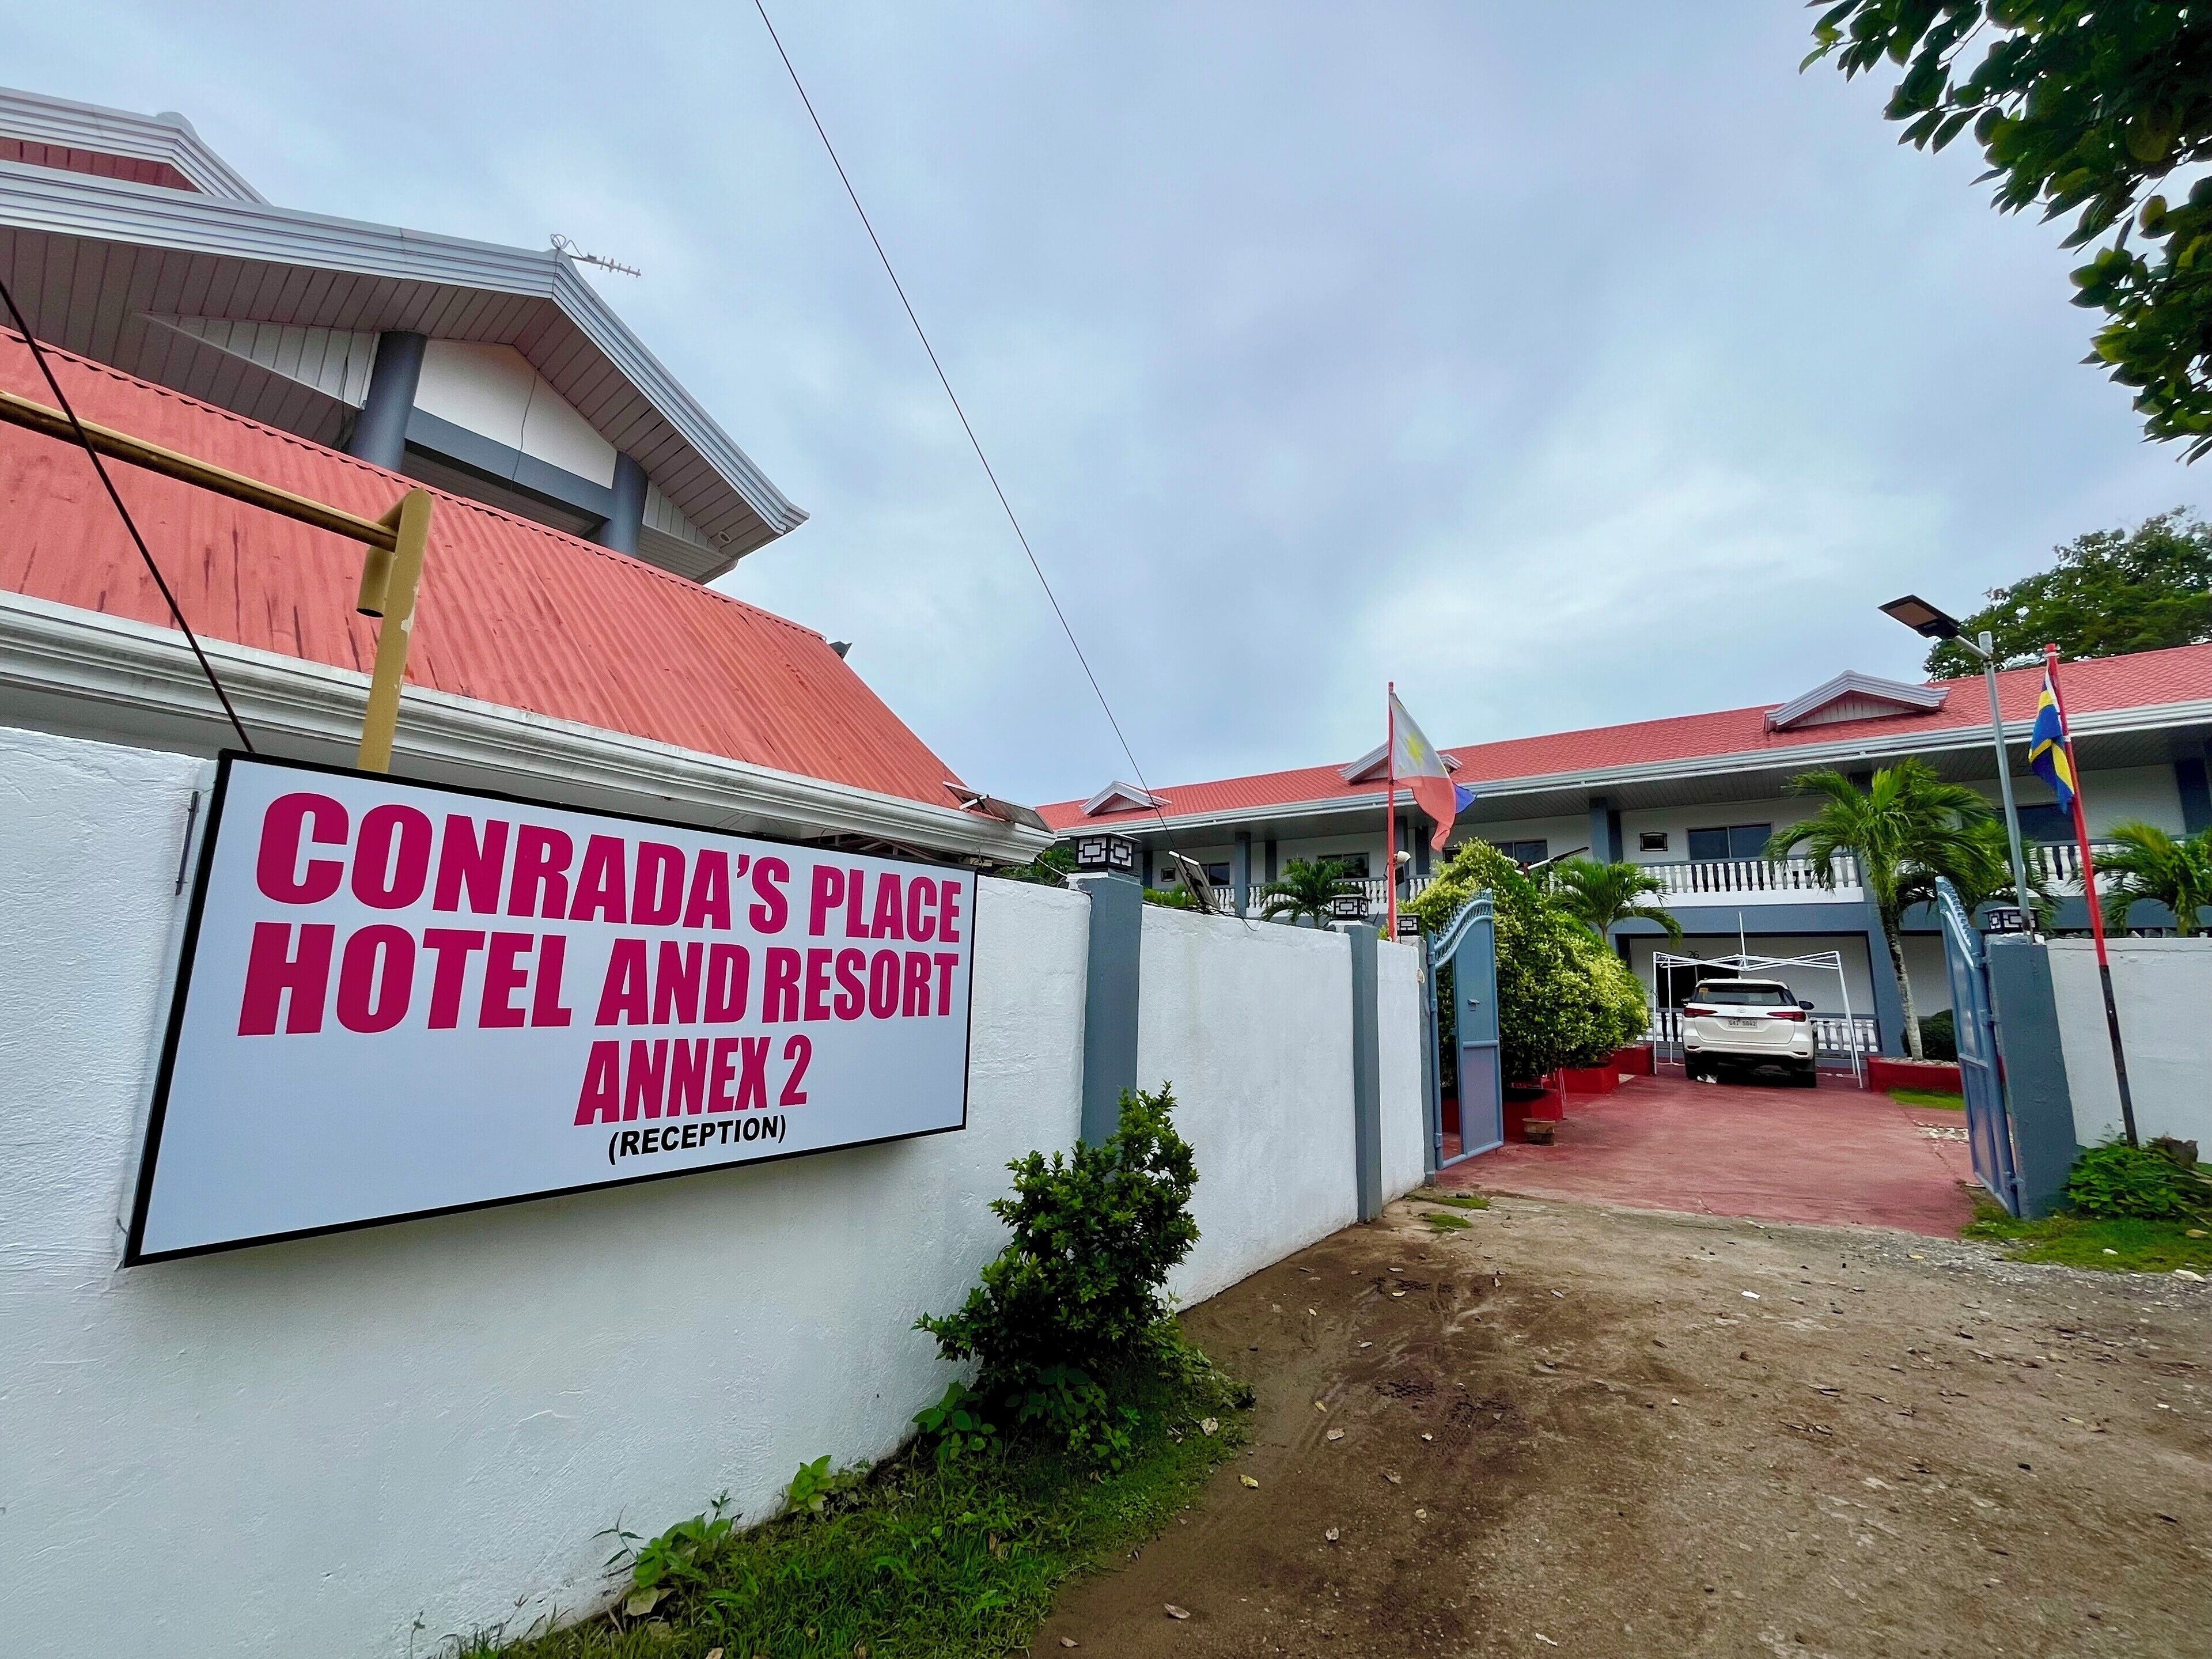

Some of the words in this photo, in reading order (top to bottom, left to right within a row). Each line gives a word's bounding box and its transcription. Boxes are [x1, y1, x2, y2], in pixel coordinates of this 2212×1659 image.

[257, 793, 789, 937] CONRADA'S
[808, 865, 961, 944] PLACE
[238, 922, 572, 1036] HOTEL
[595, 938, 751, 1027] AND
[762, 947, 959, 1021] RESORT
[1687, 950, 1699, 959] 26
[574, 1037, 771, 1126] ANNEX
[780, 1035, 812, 1107] 2
[608, 1113, 786, 1166] (RECEPTION)
